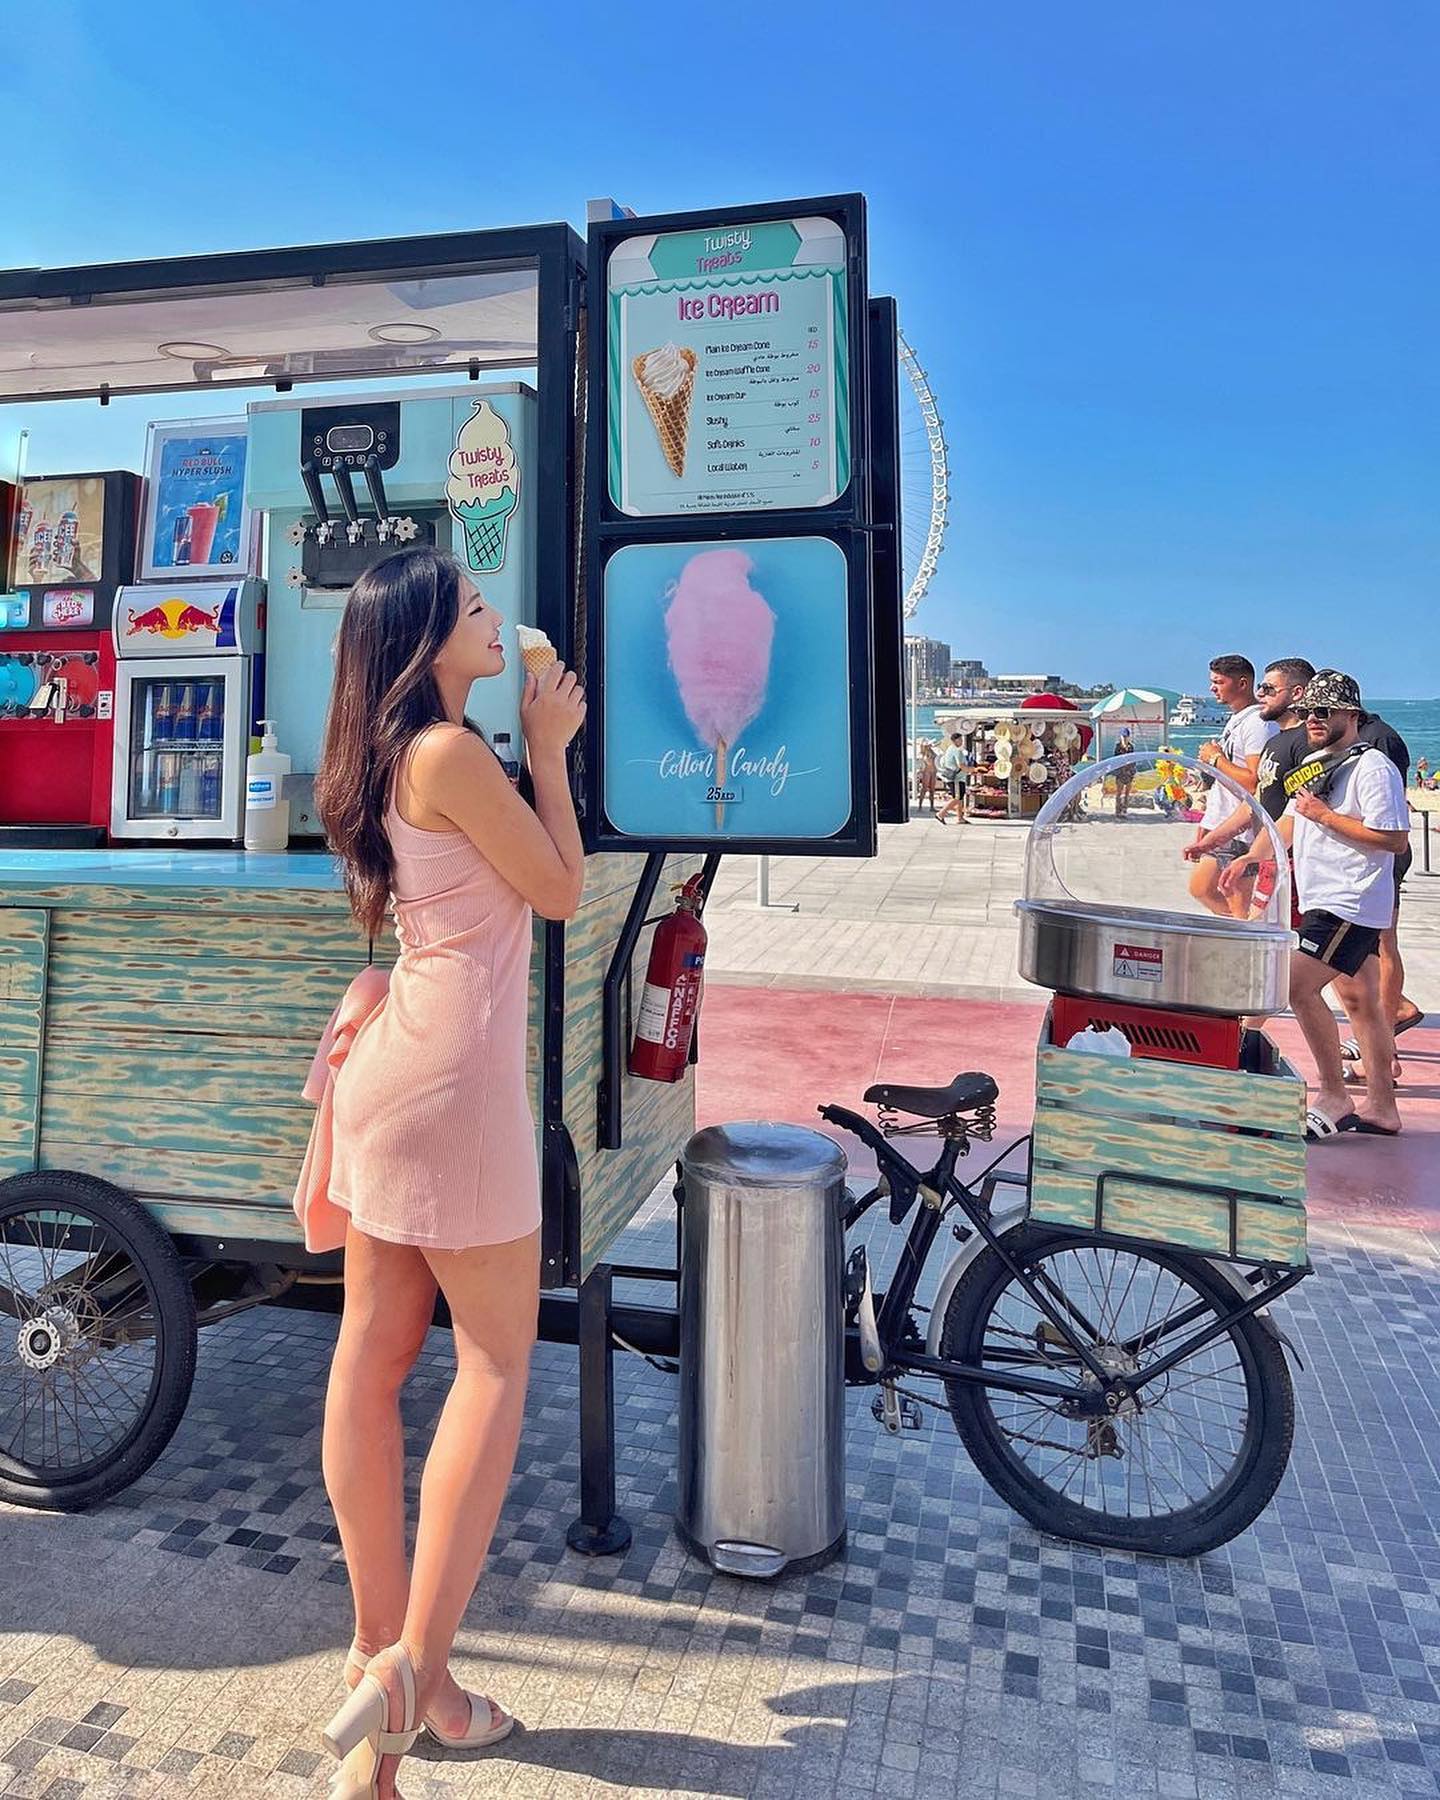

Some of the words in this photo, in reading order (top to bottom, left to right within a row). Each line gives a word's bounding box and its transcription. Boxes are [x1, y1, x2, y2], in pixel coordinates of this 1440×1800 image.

[704, 229, 752, 252] Twisty
[679, 296, 704, 320] Ice
[808, 339, 819, 349] 15
[806, 363, 820, 374] 20
[808, 388, 820, 399] 15
[706, 416, 728, 428] Slushy
[807, 413, 820, 423] 25
[810, 437, 820, 447] 10
[458, 446, 504, 466] Twisty
[183, 459, 199, 467] RED
[811, 460, 820, 470] 5
[172, 467, 201, 477] HYPER
[202, 466, 232, 475] SLUSH
[654, 749, 714, 779] Cotton
[731, 745, 802, 797] Candy
[665, 986, 685, 1049] NAFFCO
